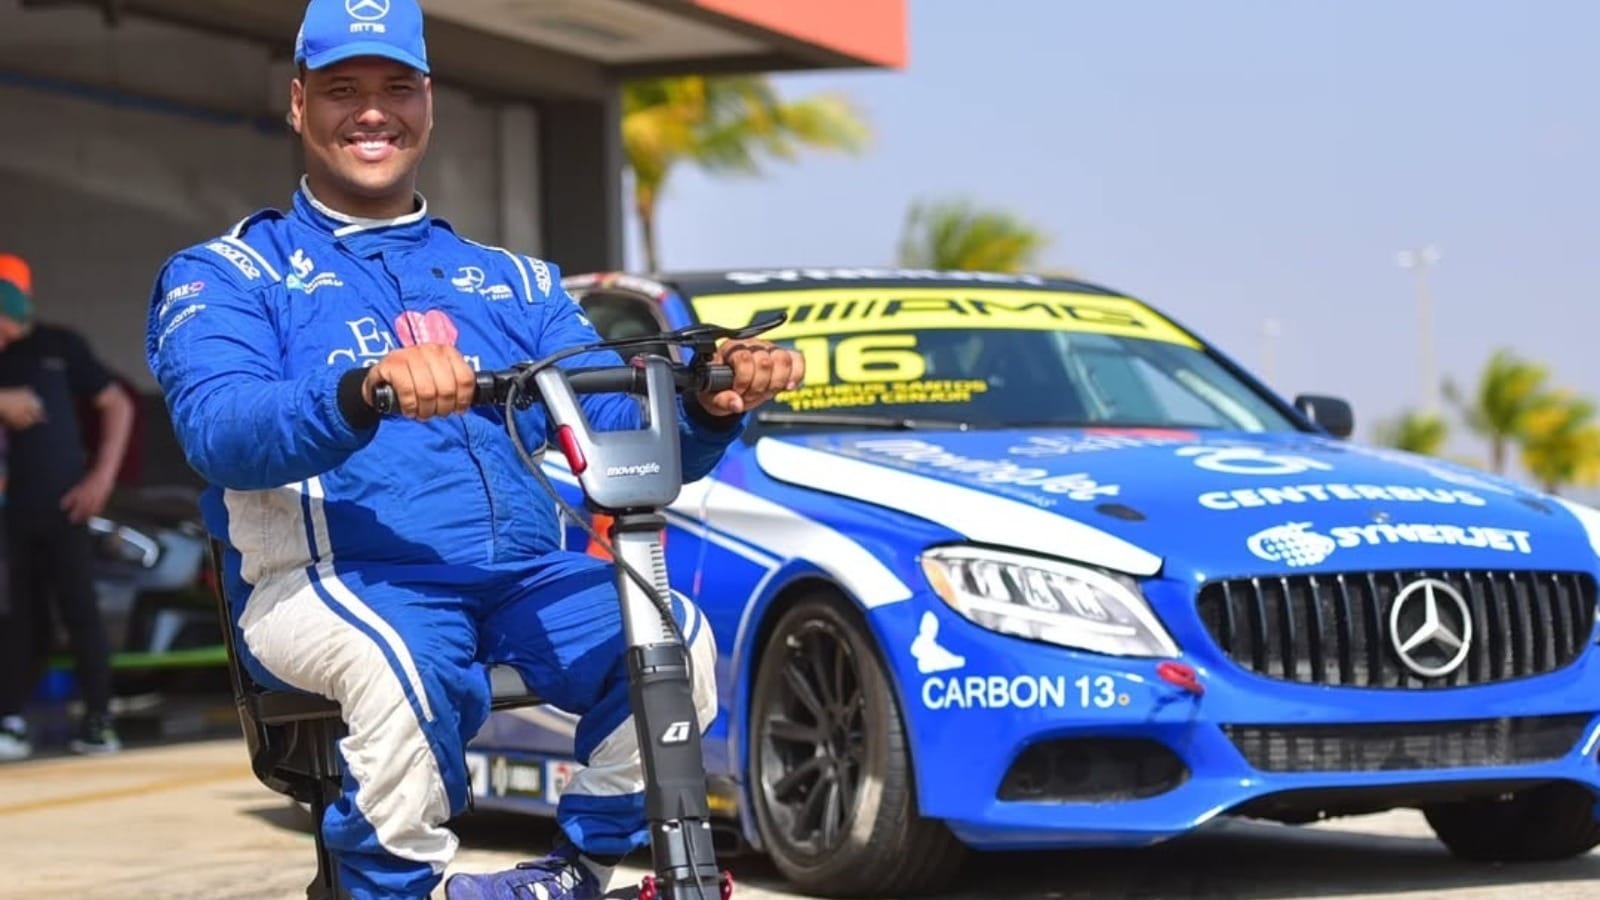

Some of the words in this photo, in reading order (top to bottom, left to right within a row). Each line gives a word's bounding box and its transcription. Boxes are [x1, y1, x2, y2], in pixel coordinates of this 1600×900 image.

[794, 334, 926, 387] 16
[607, 462, 660, 476] movinglife
[1199, 484, 1486, 509] CENTERBUS
[1330, 523, 1532, 554] SYNERJET
[922, 676, 1065, 710] CARBON
